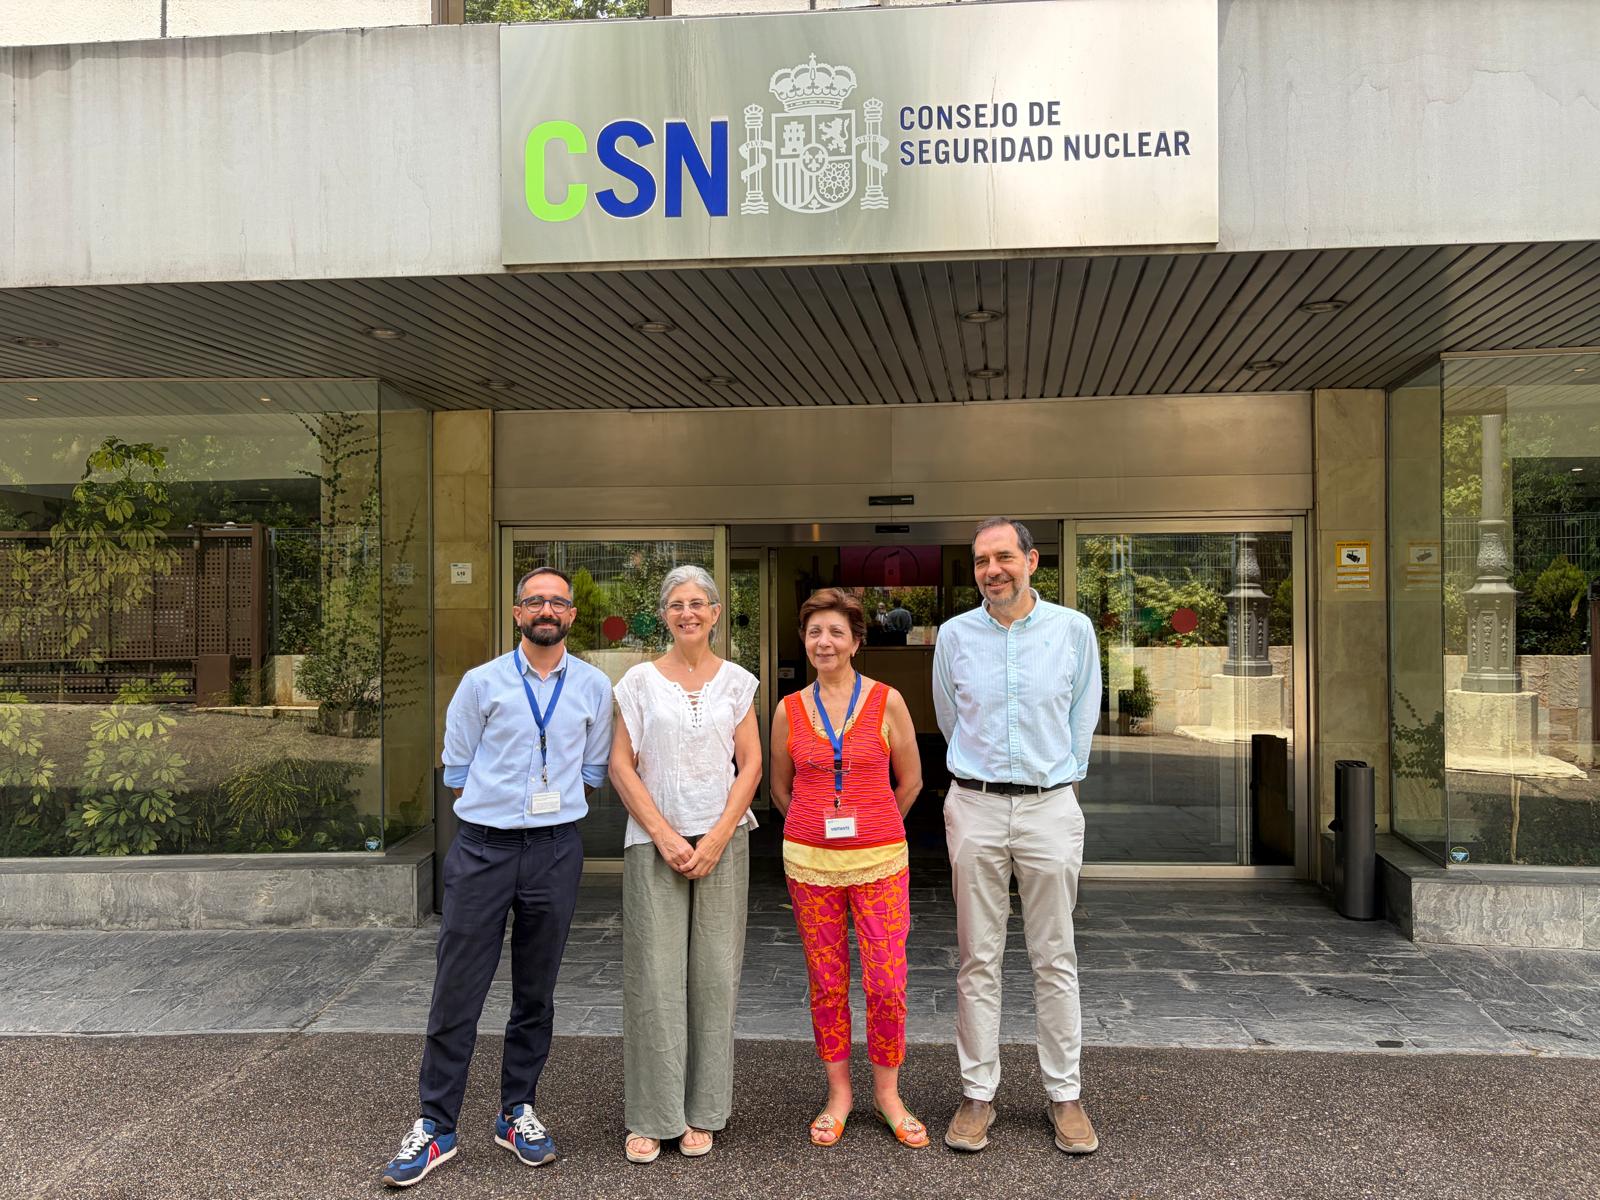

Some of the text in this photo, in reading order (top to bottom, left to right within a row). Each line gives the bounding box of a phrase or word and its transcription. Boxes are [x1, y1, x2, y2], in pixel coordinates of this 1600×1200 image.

[899, 101, 1061, 131] CONSEJO DE
[899, 131, 1191, 166] SEGURIDAD NUCLEAR
[524, 116, 729, 222] CSN
